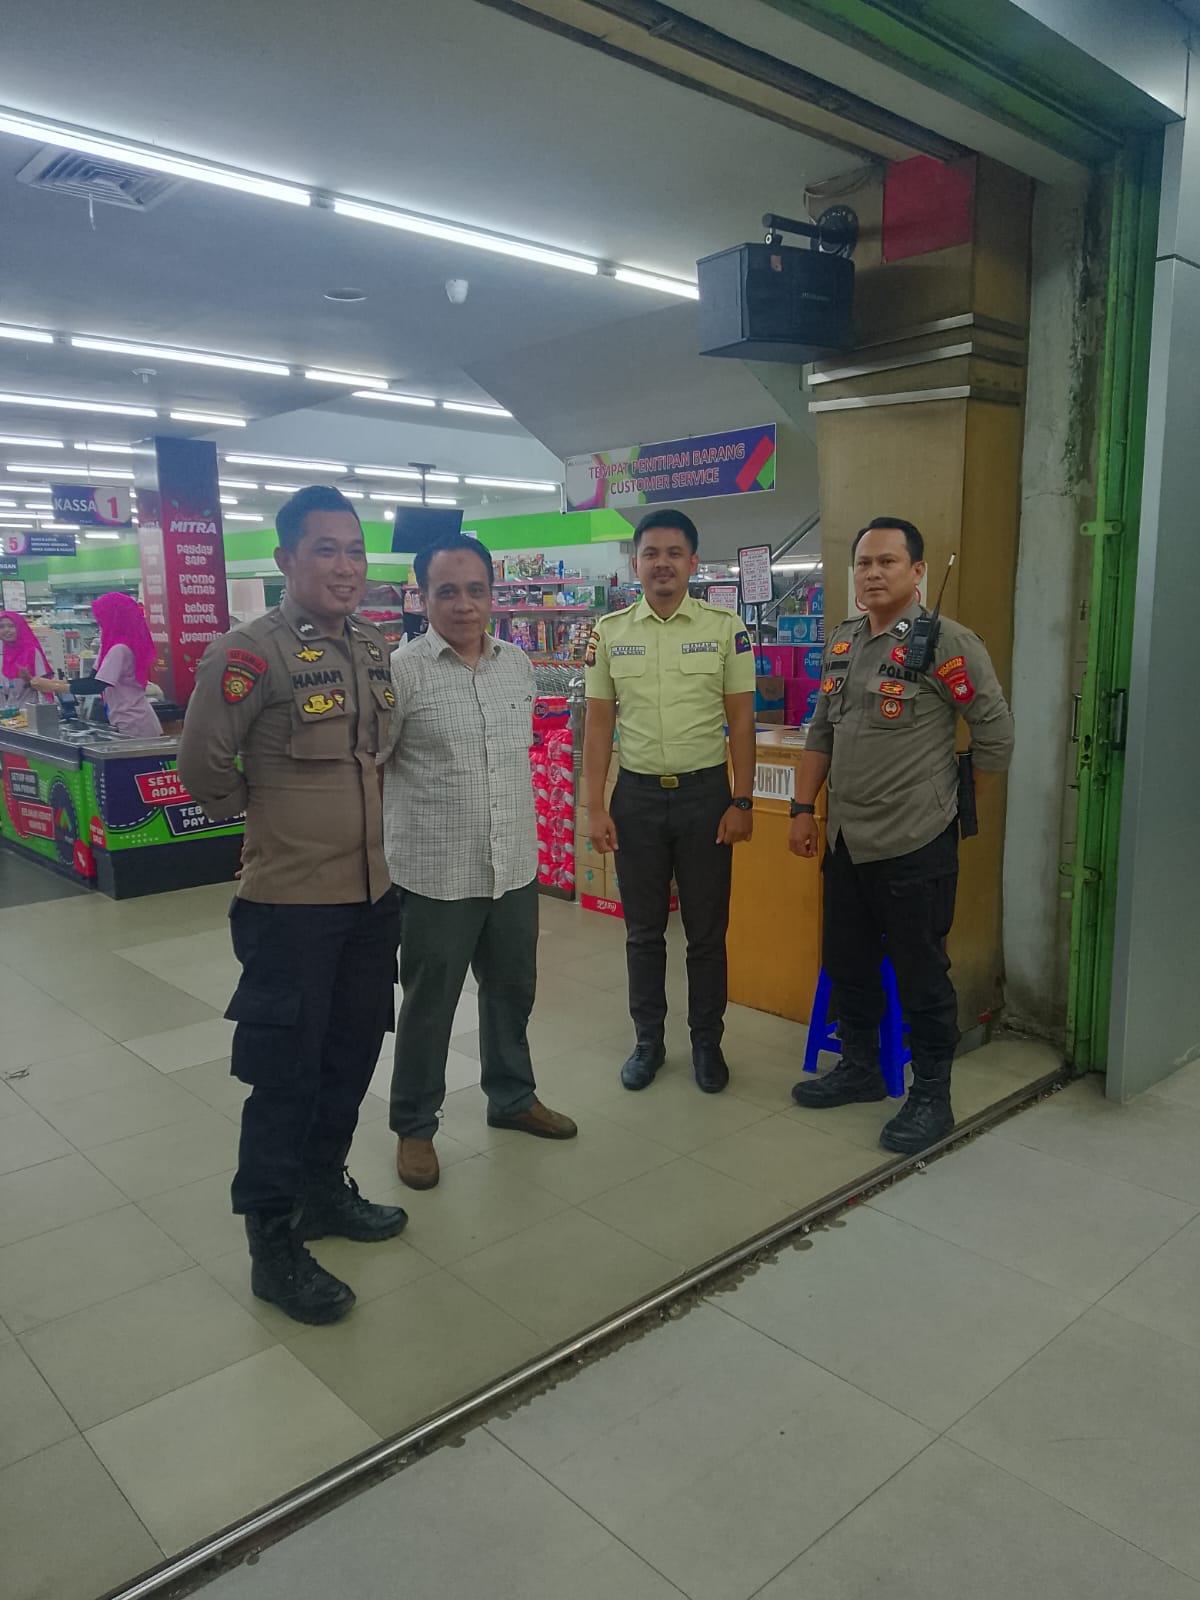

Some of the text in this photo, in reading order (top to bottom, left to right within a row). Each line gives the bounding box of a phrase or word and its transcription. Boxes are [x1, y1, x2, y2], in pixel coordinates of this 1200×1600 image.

[588, 443, 746, 480] TEMPAT PENITIPAN BARANG
[610, 467, 720, 495] CUSTOMER SERVICE
[53, 496, 119, 519] KASSA 1
[169, 521, 217, 535] MITRA
[8, 536, 18, 552] 5
[184, 555, 207, 566] sale
[178, 573, 216, 585] promo
[184, 602, 216, 614] tebus
[182, 613, 219, 625] murah
[292, 669, 344, 689] HANAFI
[878, 664, 918, 682] POLRI
[151, 786, 177, 798] ADA
[182, 816, 205, 829] PAY
